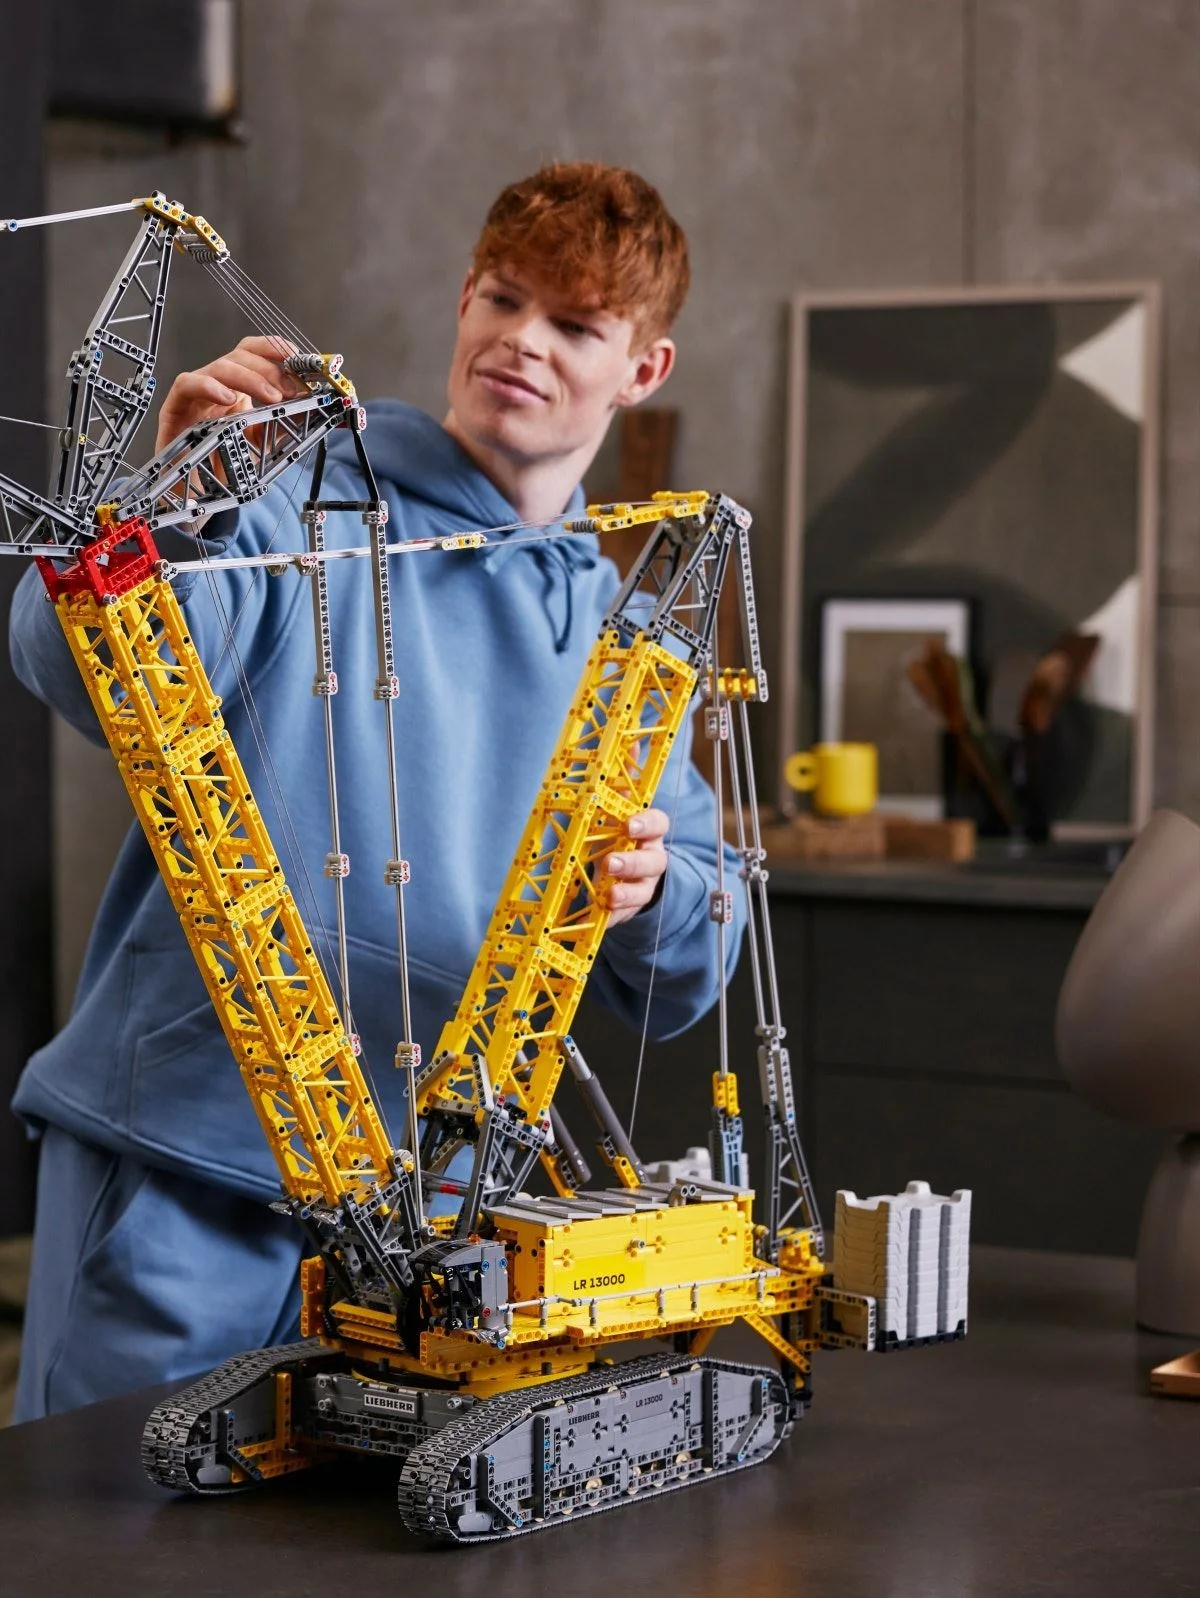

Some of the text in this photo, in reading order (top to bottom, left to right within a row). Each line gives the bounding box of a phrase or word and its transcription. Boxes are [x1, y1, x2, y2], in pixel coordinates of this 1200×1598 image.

[573, 1273, 626, 1291] LR 13000
[365, 1396, 414, 1412] LIEBHERR
[635, 1393, 663, 1408] LR 13000
[568, 1410, 600, 1426] LIEBHERR
